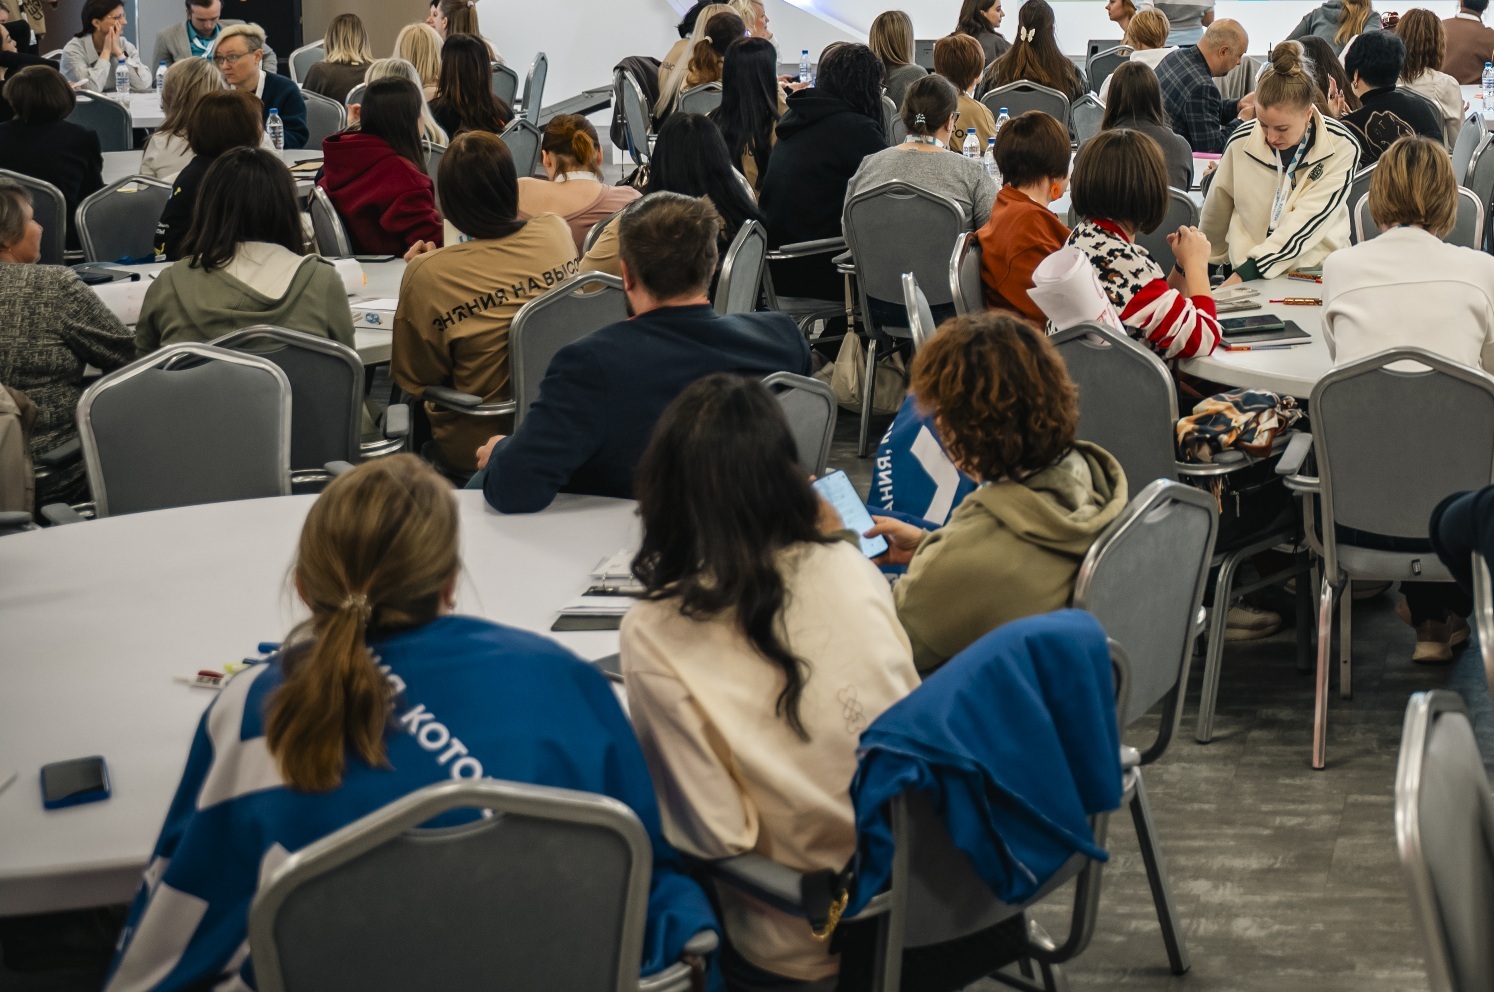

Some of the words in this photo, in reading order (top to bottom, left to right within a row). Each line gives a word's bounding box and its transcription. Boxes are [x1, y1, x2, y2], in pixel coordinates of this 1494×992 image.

[432, 288, 509, 333] ЗНАНИЯ
[512, 278, 541, 299] НА
[401, 703, 484, 784] КОТО
